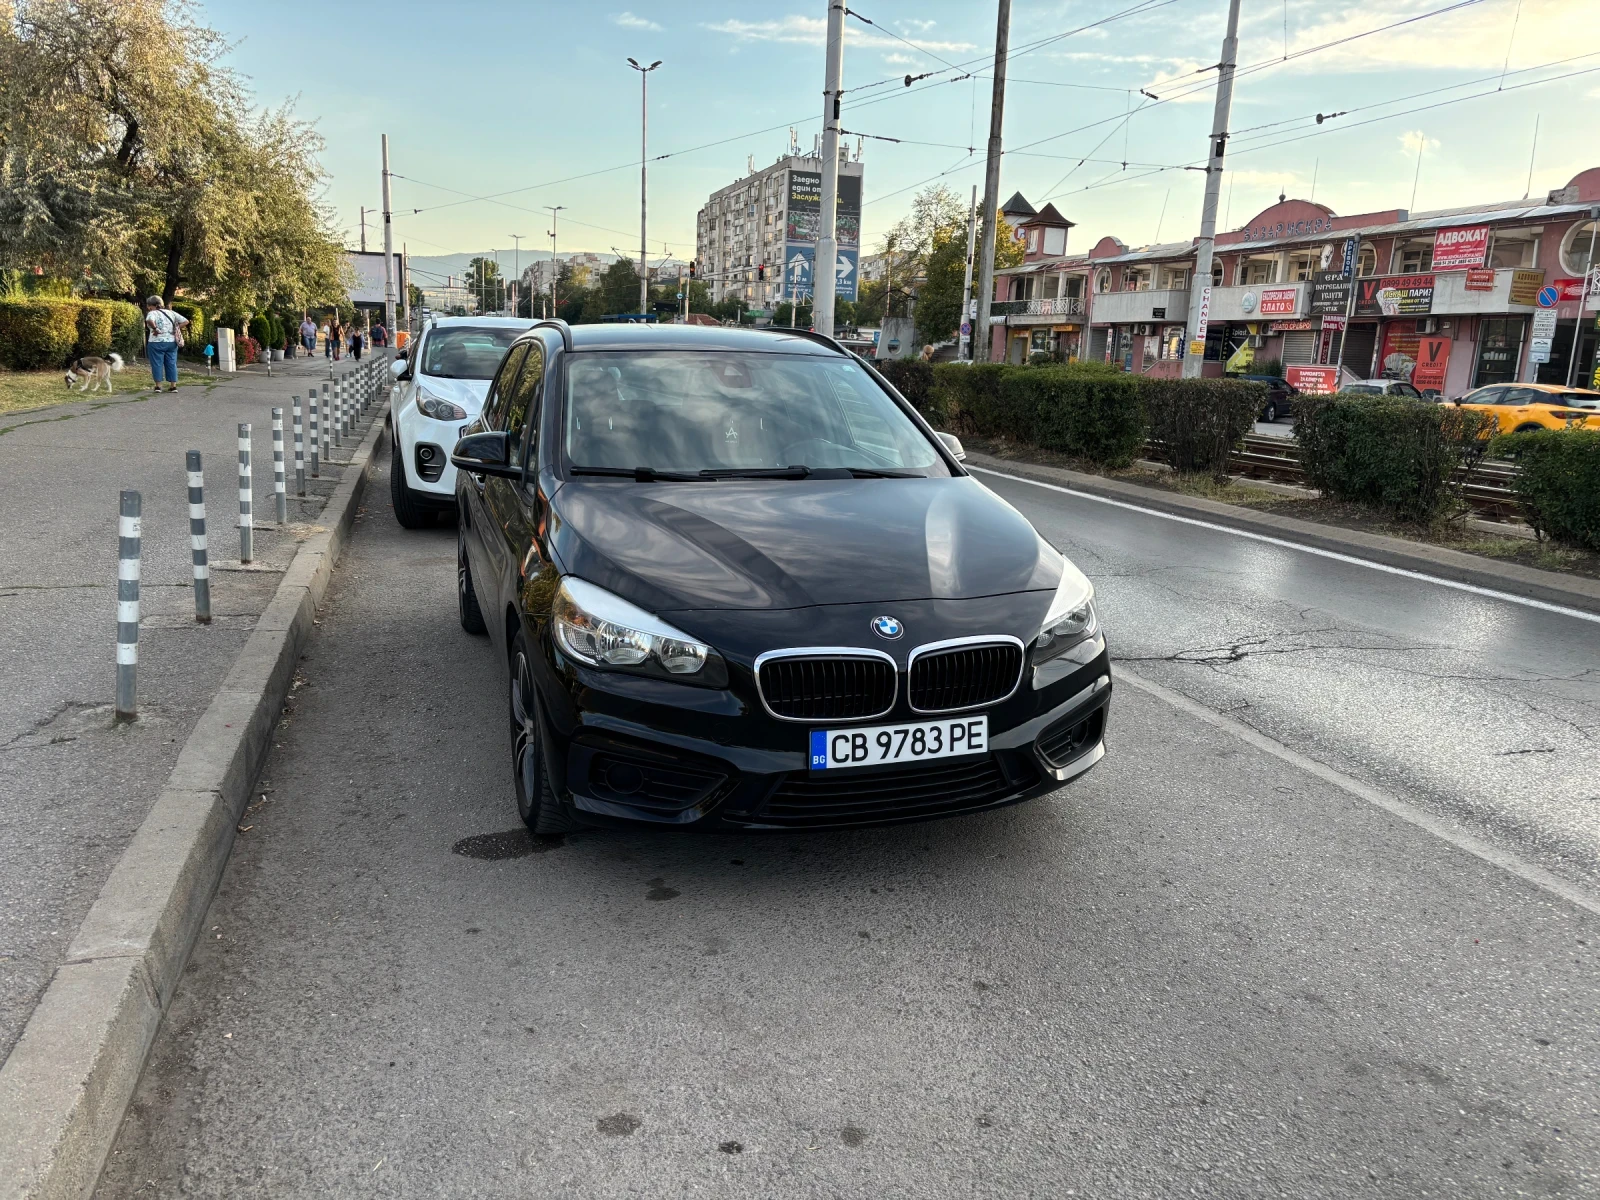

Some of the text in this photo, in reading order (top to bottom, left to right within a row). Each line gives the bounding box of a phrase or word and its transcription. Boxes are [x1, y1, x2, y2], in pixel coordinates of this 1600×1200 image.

[792, 174, 820, 185] Заедно
[792, 185, 811, 193] един
[1244, 217, 1332, 242] БАЗАР ИСКРА
[1436, 228, 1488, 246] АДВОКАТ
[1343, 240, 1354, 277] ПРЕВОДИ
[1363, 281, 1376, 300] V
[1382, 278, 1432, 288] 0899 49 49 44
[1384, 288, 1432, 299] ИСКАШ ПАРИ?
[1200, 288, 1210, 333] CHANGE
[1262, 302, 1285, 311] ЗЛАТО
[1429, 342, 1442, 362] V
[831, 721, 983, 763] CB 9783 PE
[813, 755, 825, 764] BG
